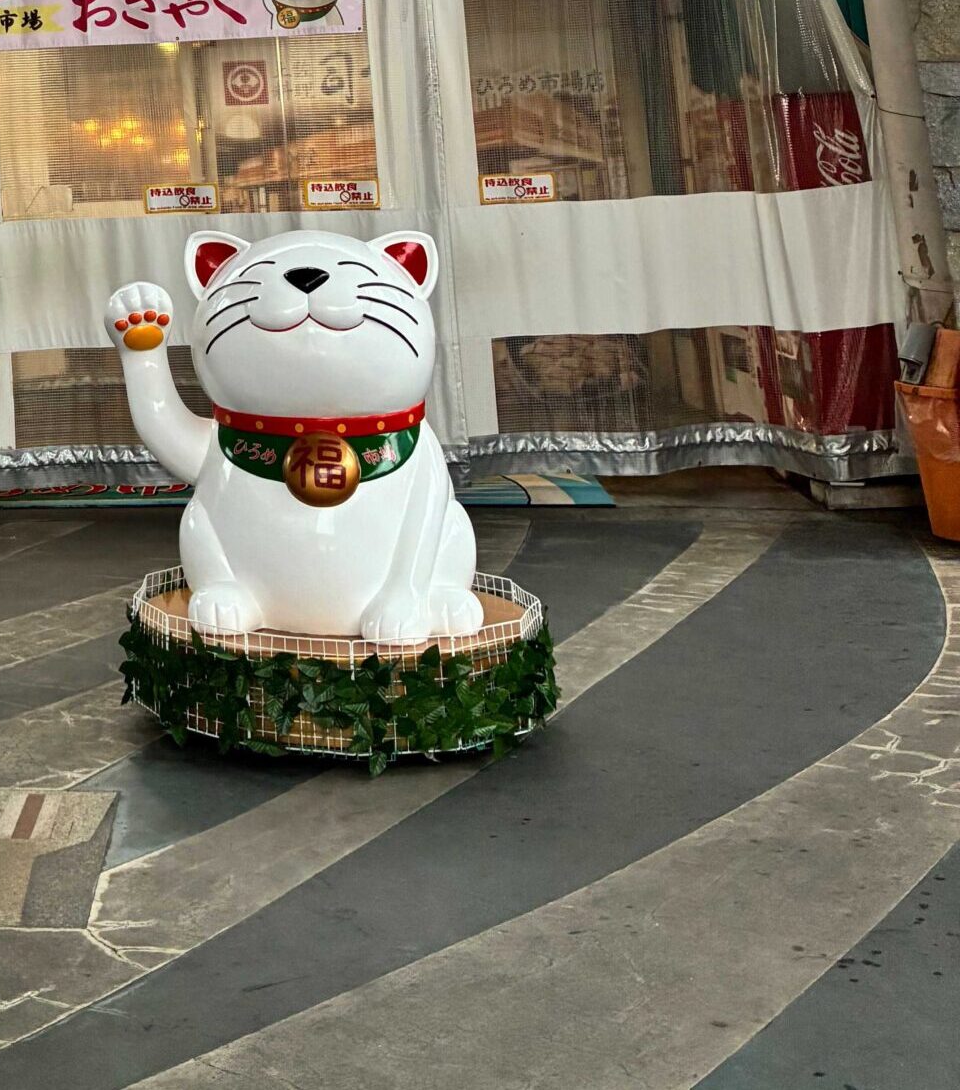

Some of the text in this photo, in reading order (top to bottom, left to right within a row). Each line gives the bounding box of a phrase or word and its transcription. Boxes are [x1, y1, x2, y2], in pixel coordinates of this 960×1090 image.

[525, 185, 549, 195] 禁止
[190, 196, 212, 205] 禁止
[351, 191, 373, 201] 禁止
[233, 438, 277, 465] ひろめ
[291, 438, 347, 490] 福
